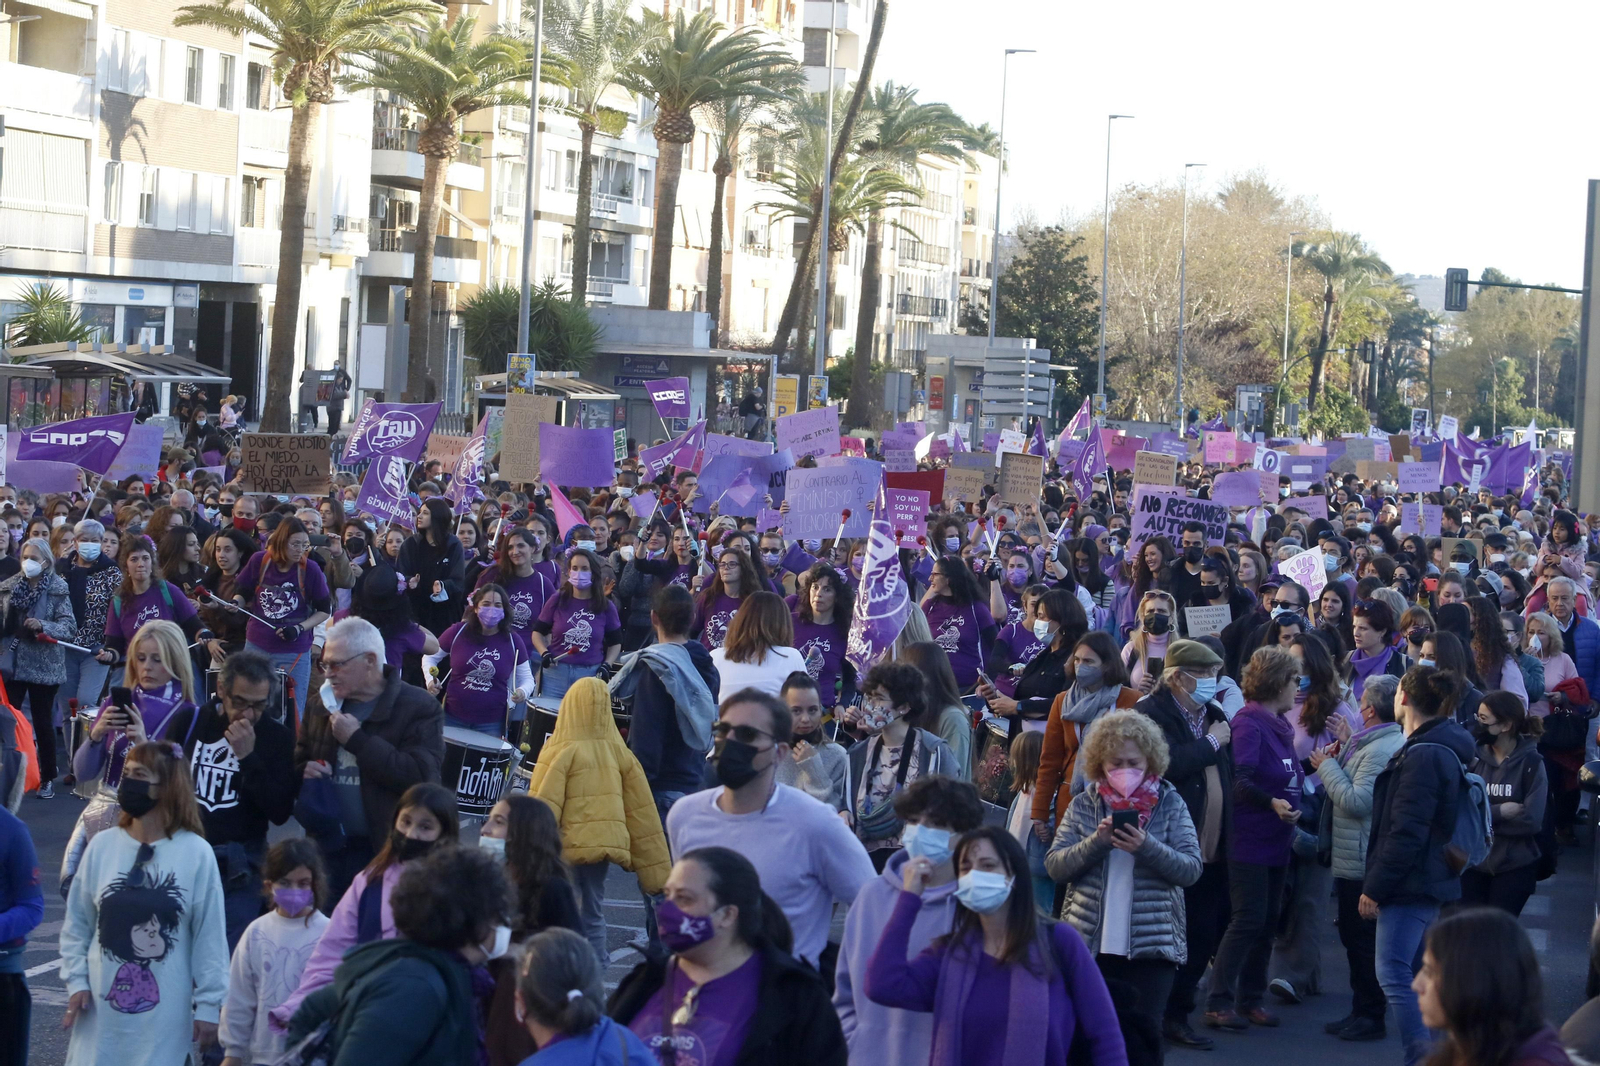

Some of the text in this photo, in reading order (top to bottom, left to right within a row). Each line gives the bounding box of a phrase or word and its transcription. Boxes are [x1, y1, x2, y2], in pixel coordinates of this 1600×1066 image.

[510, 409, 546, 424] TODAS
[517, 424, 540, 438] VOLA
[248, 436, 285, 449] DONDE
[506, 438, 535, 451] SOBRE
[249, 450, 261, 463] EL
[502, 450, 532, 465] TECHO
[245, 463, 320, 478] HOY GRITA LA
[253, 476, 296, 493] RABIA
[788, 470, 868, 490] LO CONTRARIO AL
[965, 475, 983, 488] piropo
[790, 488, 853, 512] FEMINISMO
[895, 494, 907, 502] YO
[1140, 494, 1162, 513] NO
[908, 524, 919, 532] ME
[1144, 515, 1224, 540] AUTOAD
[195, 767, 237, 804] NFL
